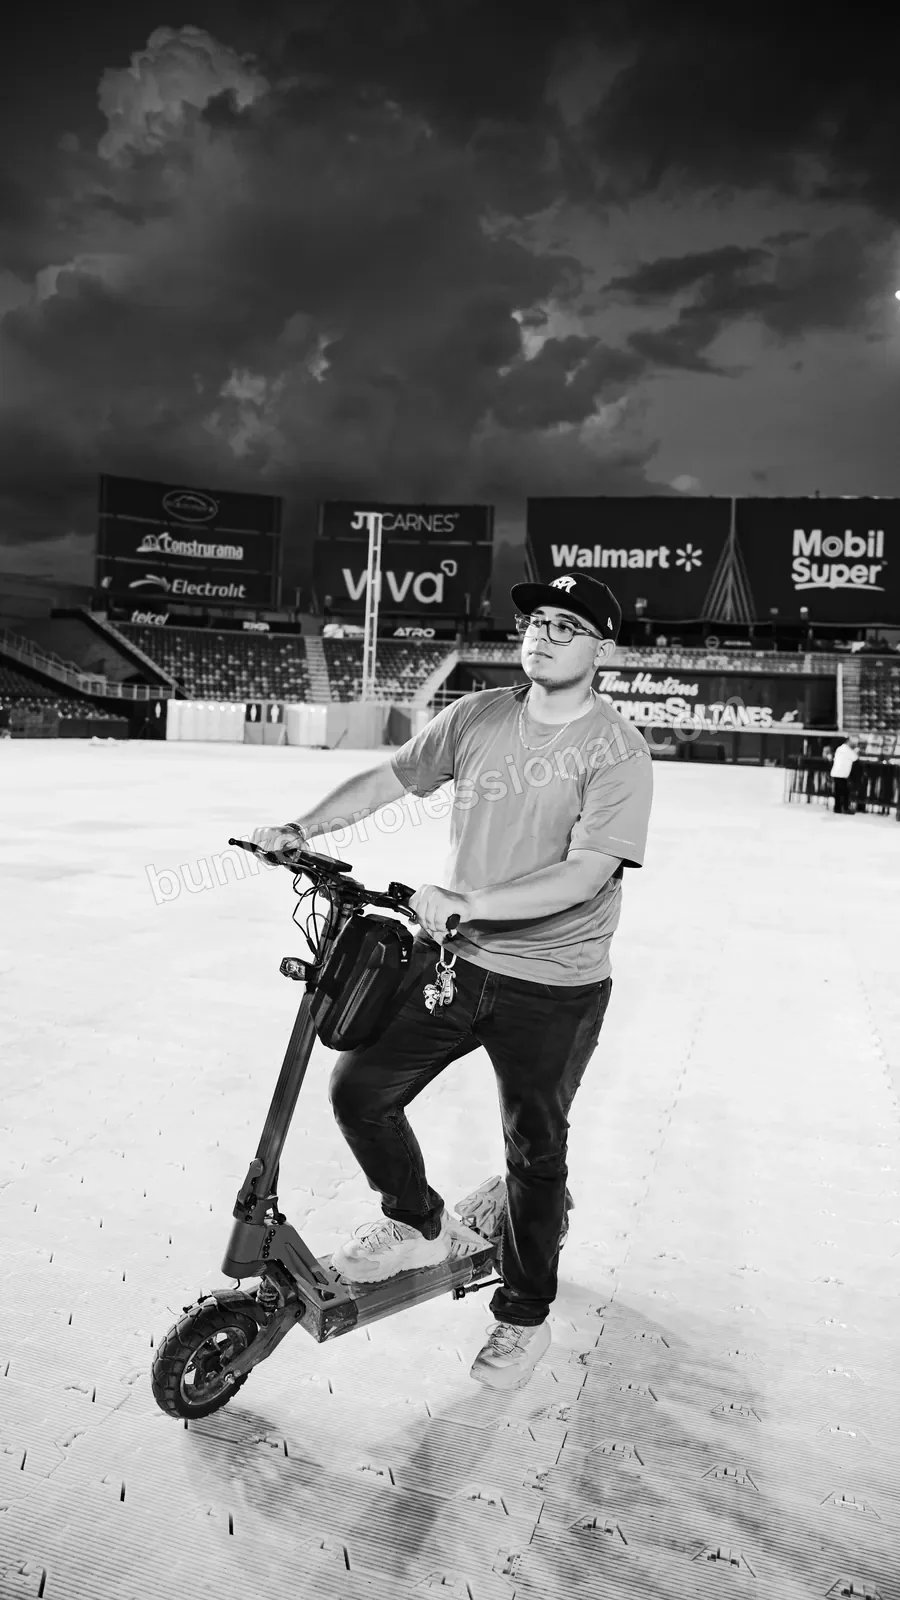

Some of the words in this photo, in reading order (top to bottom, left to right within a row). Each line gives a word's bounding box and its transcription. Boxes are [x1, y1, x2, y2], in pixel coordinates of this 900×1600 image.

[164, 537, 244, 560] Construrama
[792, 528, 884, 558] Mobil
[550, 544, 670, 569] Walmart
[791, 556, 882, 590] Super
[172, 578, 247, 599] Electrolit
[130, 609, 170, 626] telcel
[392, 626, 436, 639] ATRO
[598, 671, 630, 694] Tim
[630, 671, 699, 697] Hortons
